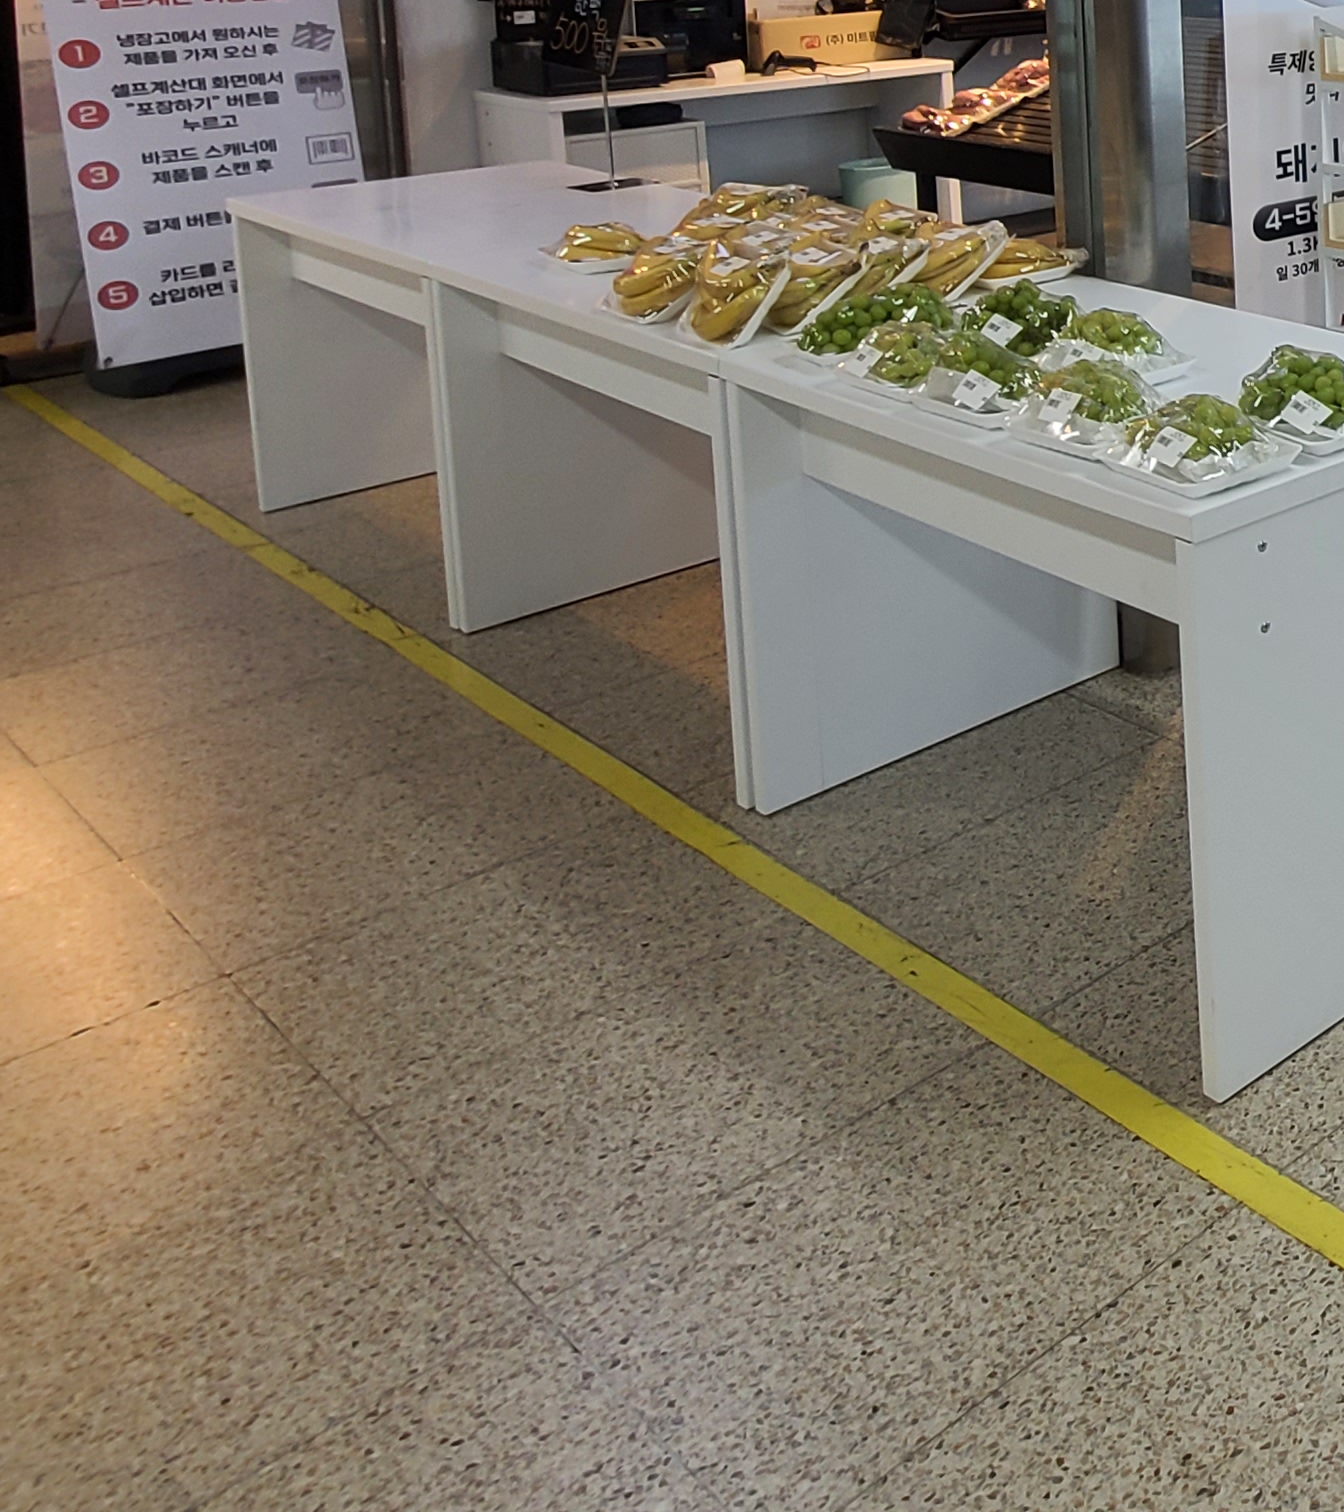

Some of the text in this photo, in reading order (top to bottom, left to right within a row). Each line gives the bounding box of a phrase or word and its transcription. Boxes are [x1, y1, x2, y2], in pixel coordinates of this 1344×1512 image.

[116, 25, 280, 48] 냉장고에서 원하시는
[550, 12, 590, 54] 500
[826, 33, 844, 46] (주)
[123, 43, 279, 66] 제품을 가져 오신 후
[111, 70, 285, 98] 셀프계산대 화면에서
[226, 90, 280, 108] 버튼을
[78, 105, 99, 124] 2
[182, 115, 239, 131] 누르고
[141, 138, 278, 165] 바코드 스캐너에
[89, 166, 108, 184] 3
[152, 158, 274, 185] 제품을 스캔 후
[98, 225, 118, 243] 4
[142, 217, 181, 236] 결제
[160, 262, 217, 283] 카드를
[1276, 266, 1289, 282] 일
[107, 285, 128, 304] 5
[148, 281, 224, 307] 삽입하면
